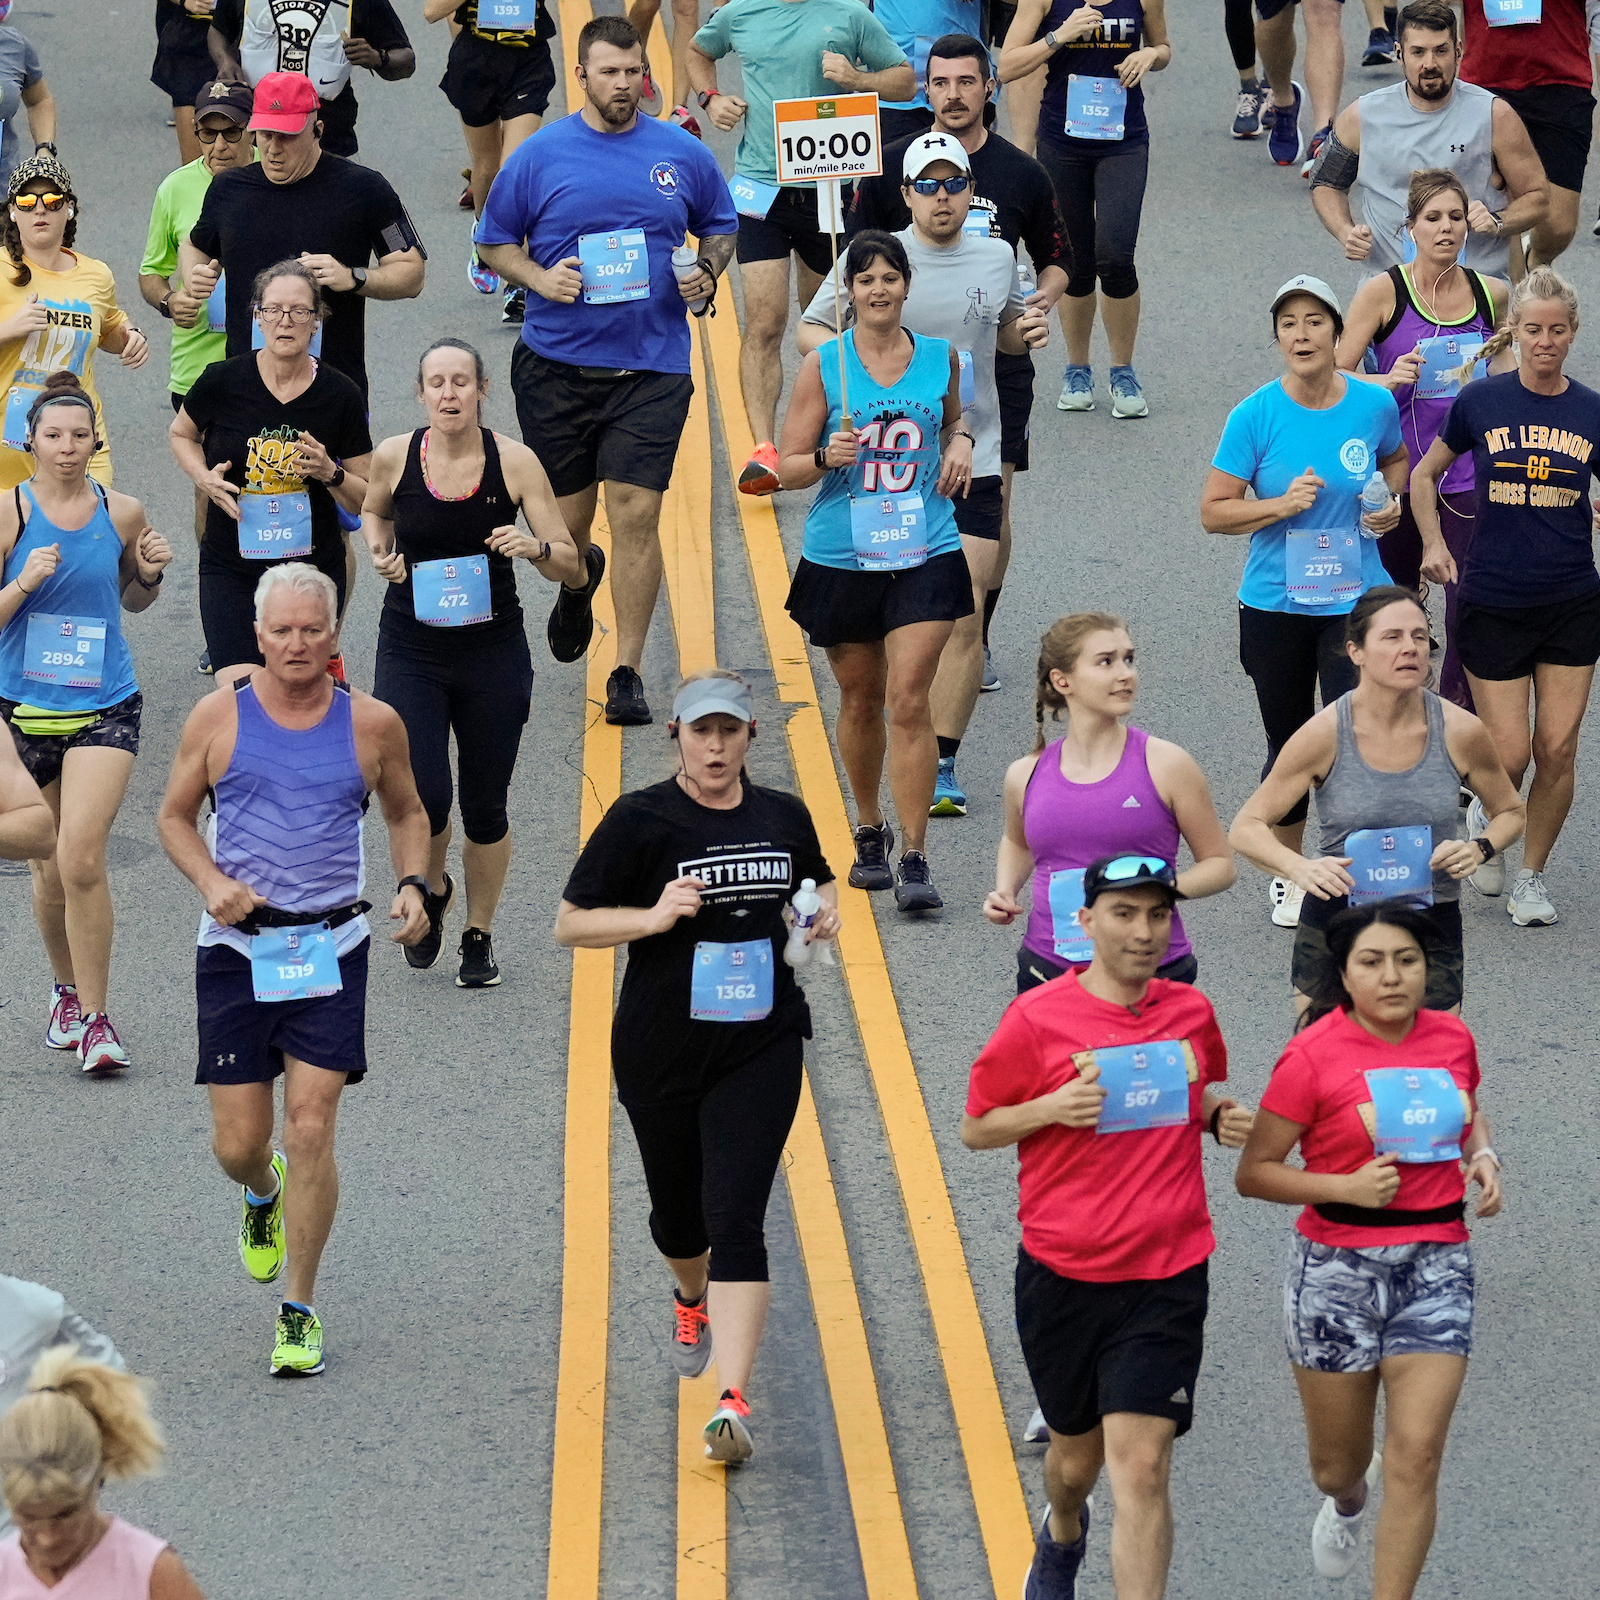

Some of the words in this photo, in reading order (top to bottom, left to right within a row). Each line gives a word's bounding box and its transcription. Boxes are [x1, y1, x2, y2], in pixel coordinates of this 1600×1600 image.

[493, 5, 519, 16] 1393
[1498, 0, 1523, 11] 1515
[1081, 105, 1109, 117] 1352
[781, 131, 871, 163] 10:00
[794, 162, 838, 176] min/mile
[841, 161, 865, 172] Pace
[733, 183, 755, 200] 973
[595, 261, 632, 277] 3047
[590, 293, 608, 303] Gear
[610, 292, 627, 302] Check
[1483, 426, 1516, 456] MT.
[1518, 425, 1594, 465] LEBANON
[873, 451, 906, 462] EQT
[1487, 480, 1526, 505] CROSS
[1528, 481, 1581, 507] COUNTRY
[256, 528, 292, 541] 1976
[870, 527, 910, 544] 2985
[864, 560, 882, 570] Gear
[885, 559, 904, 569] Check
[1304, 563, 1342, 577] 2375
[438, 594, 468, 608] 472
[1295, 595, 1310, 604] Gear
[1313, 594, 1335, 603] Check
[41, 650, 84, 666] 2894
[689, 860, 788, 886] FETTERMAN
[1367, 866, 1410, 881] 1089
[277, 963, 313, 980] 1319
[715, 984, 755, 1000] 1362
[1124, 1089, 1159, 1107] 567
[1402, 1108, 1437, 1124] 667
